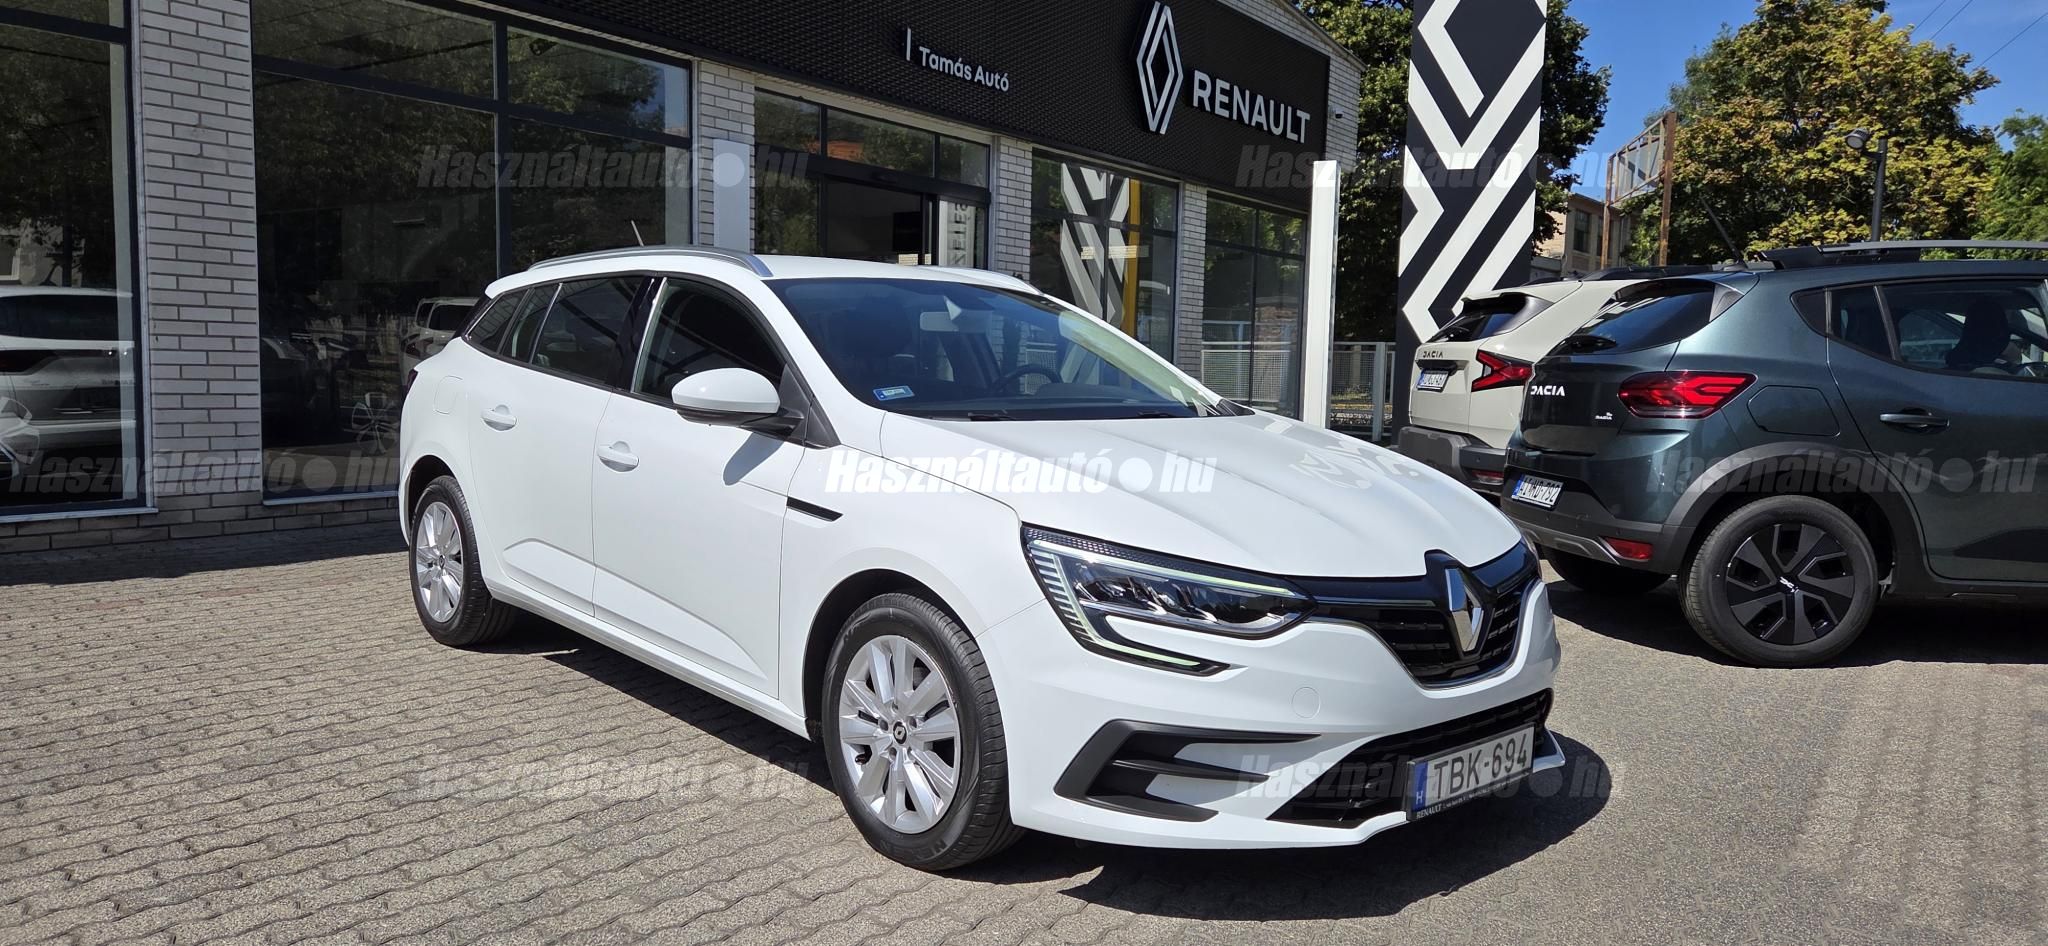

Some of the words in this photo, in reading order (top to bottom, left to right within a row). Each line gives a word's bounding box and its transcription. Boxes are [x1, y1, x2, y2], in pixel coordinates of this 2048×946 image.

[919, 46, 972, 81] Tamás
[974, 65, 1009, 92] Autó
[1193, 69, 1311, 144] RENAULT
[1422, 350, 1444, 358] DACIA
[1530, 385, 1565, 397] DACIA
[1433, 733, 1527, 800] TBK-694
